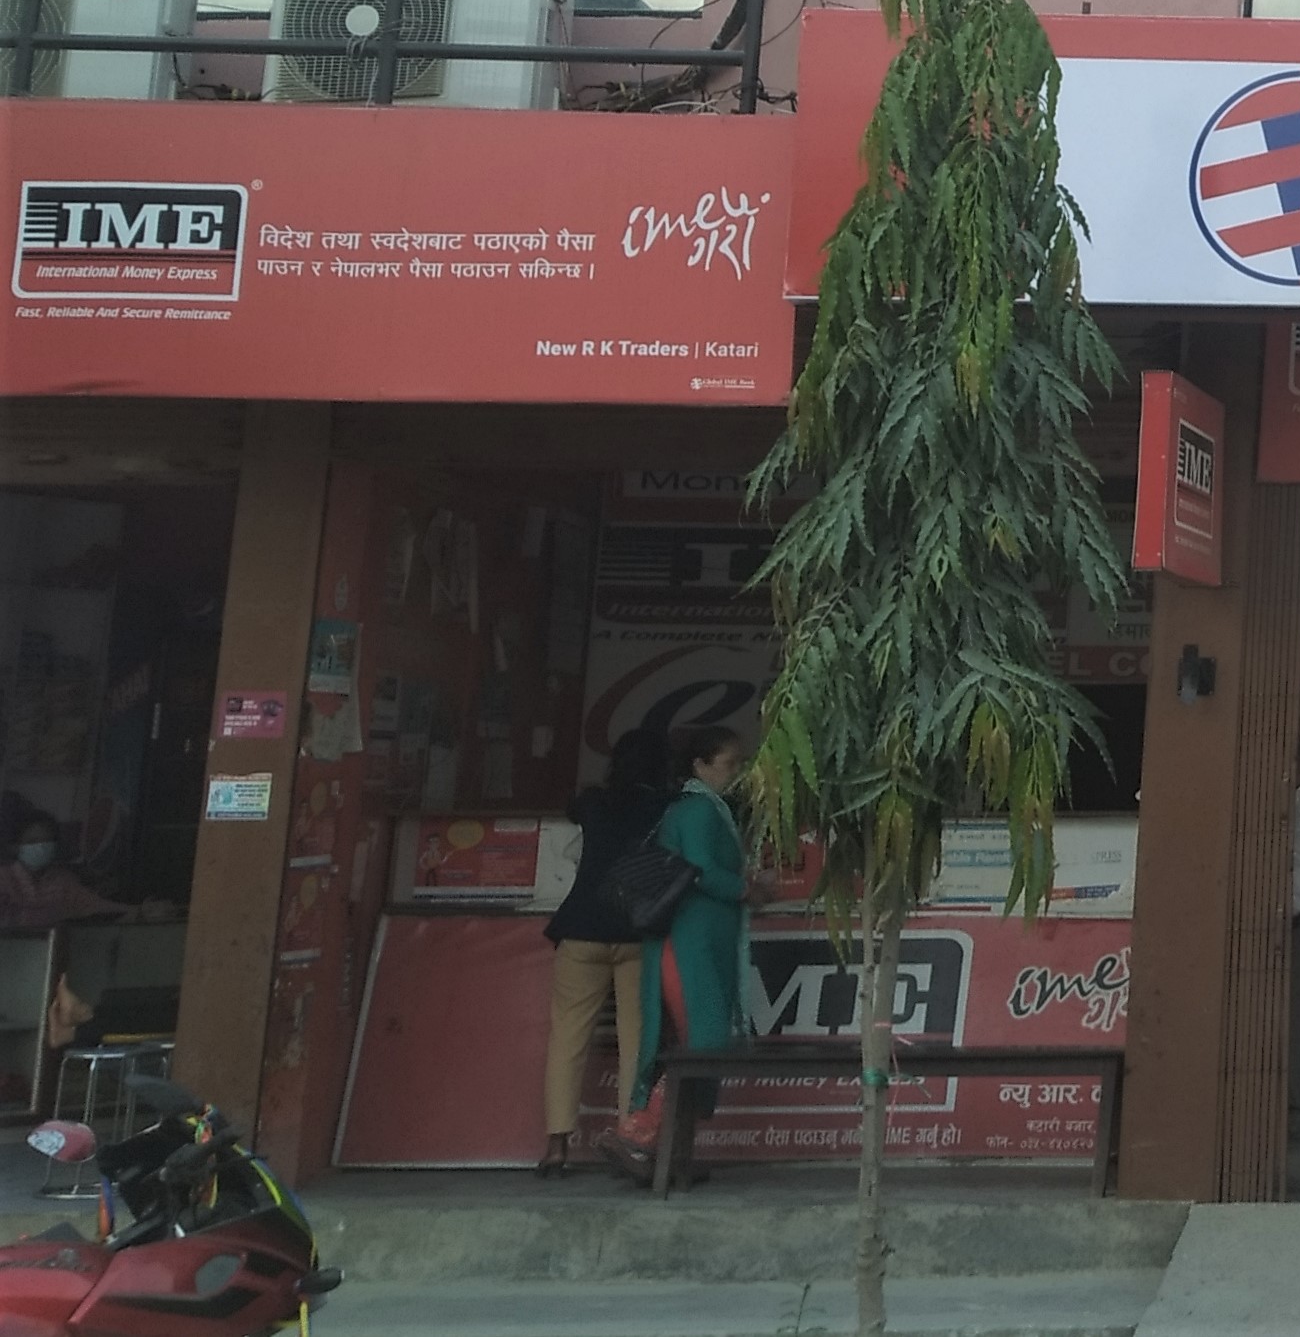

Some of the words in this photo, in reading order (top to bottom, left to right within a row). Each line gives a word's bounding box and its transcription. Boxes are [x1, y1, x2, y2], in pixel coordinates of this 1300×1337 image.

[57, 202, 225, 251] IME
[259, 224, 314, 250] विदेश
[321, 231, 362, 251] तथा
[370, 227, 466, 252] स्वदेशबाट
[473, 227, 550, 255] पठाएको
[556, 227, 597, 252] पैसा
[36, 265, 119, 279] International
[121, 266, 165, 281] Money
[167, 266, 219, 281] Express
[256, 259, 305, 277] पाउन
[311, 260, 323, 277] र
[329, 256, 403, 279] नेपालभर
[408, 257, 444, 279] पैसा
[449, 262, 510, 280] पठाउन
[46, 306, 95, 318] Reliable
[96, 307, 119, 318] And
[123, 307, 162, 320] Secure
[164, 308, 232, 321] Remittance
[536, 340, 577, 357] New
[581, 340, 596, 357] R
[599, 340, 615, 357] K
[618, 340, 690, 358] Traders
[704, 341, 760, 358] Katari
[1183, 440, 1212, 494] IME
[748, 963, 934, 1036] ME
[885, 1127, 912, 1146] IME
